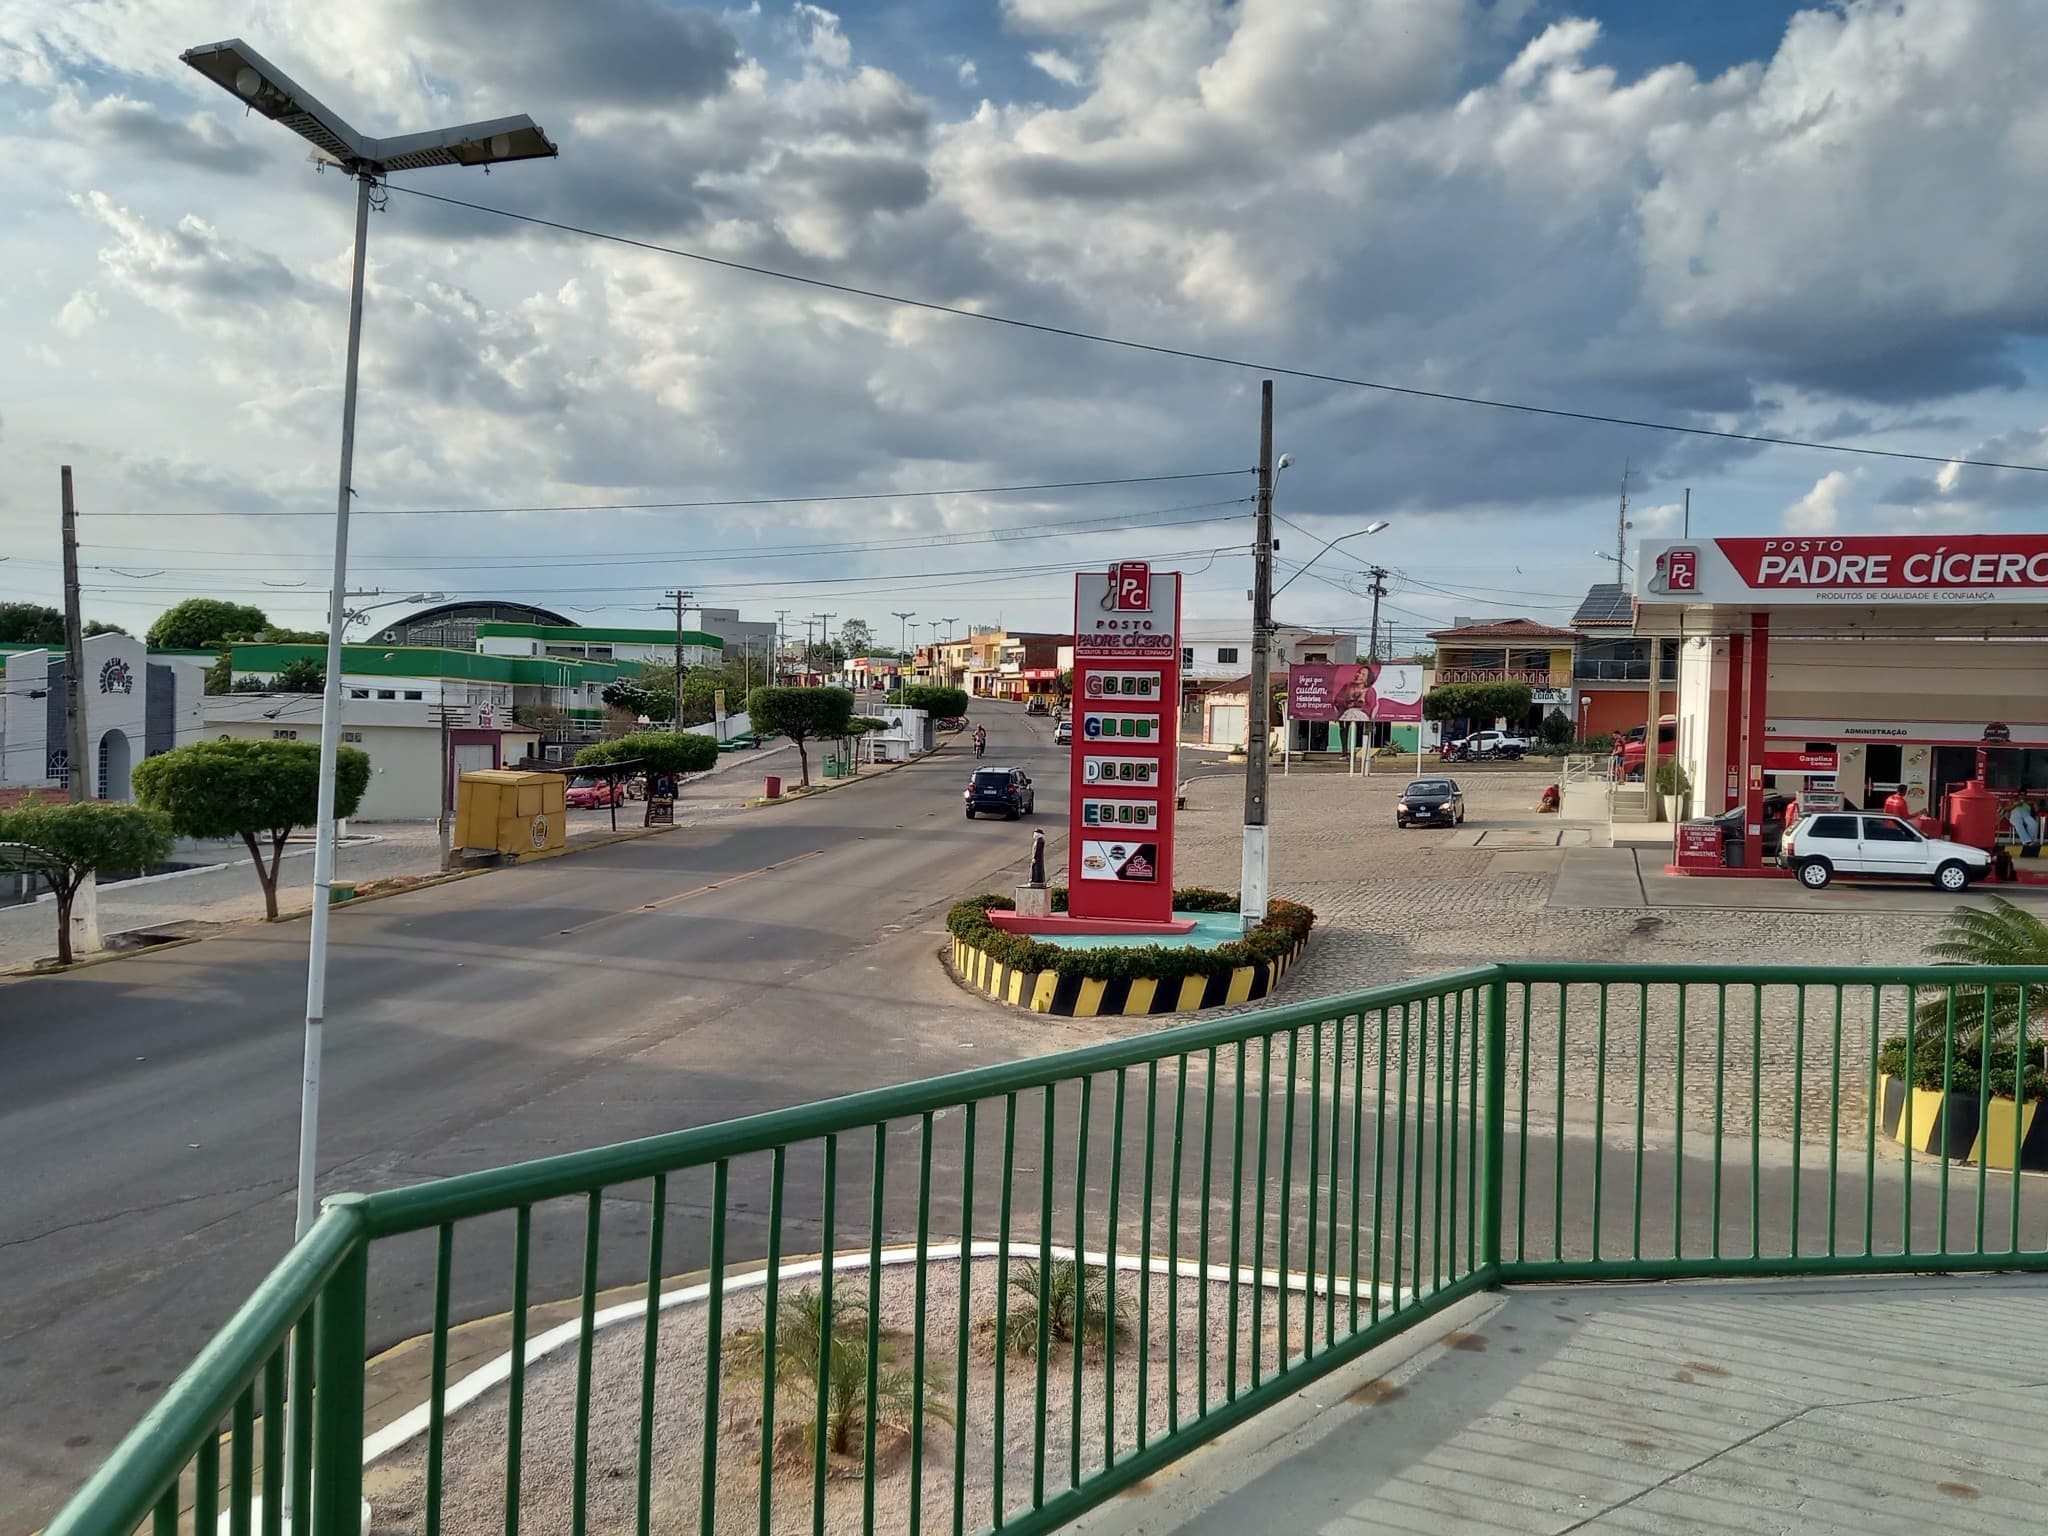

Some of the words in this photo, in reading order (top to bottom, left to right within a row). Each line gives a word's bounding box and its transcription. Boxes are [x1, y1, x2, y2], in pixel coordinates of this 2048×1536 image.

[1765, 541, 1844, 553] POSTO
[1671, 563, 1693, 588] PC
[1757, 555, 1892, 584] PADRE
[1121, 578, 1144, 606] PC
[1816, 592, 1863, 601] PRODUTOS
[1866, 592, 1878, 601] DE
[1880, 592, 1930, 601] QUALIDADE
[1932, 592, 1938, 601] E
[1941, 591, 1995, 602] CONFIANÇA
[1096, 620, 1152, 631] POSTO
[1077, 633, 1121, 648] PADRE
[1122, 630, 1173, 648] CÍCERO
[1086, 675, 1102, 695] G
[1085, 717, 1101, 737] G
[1845, 728, 1908, 736] ADMINISTRAÇÃO
[1085, 761, 1100, 781] D
[1084, 804, 1099, 823] E
